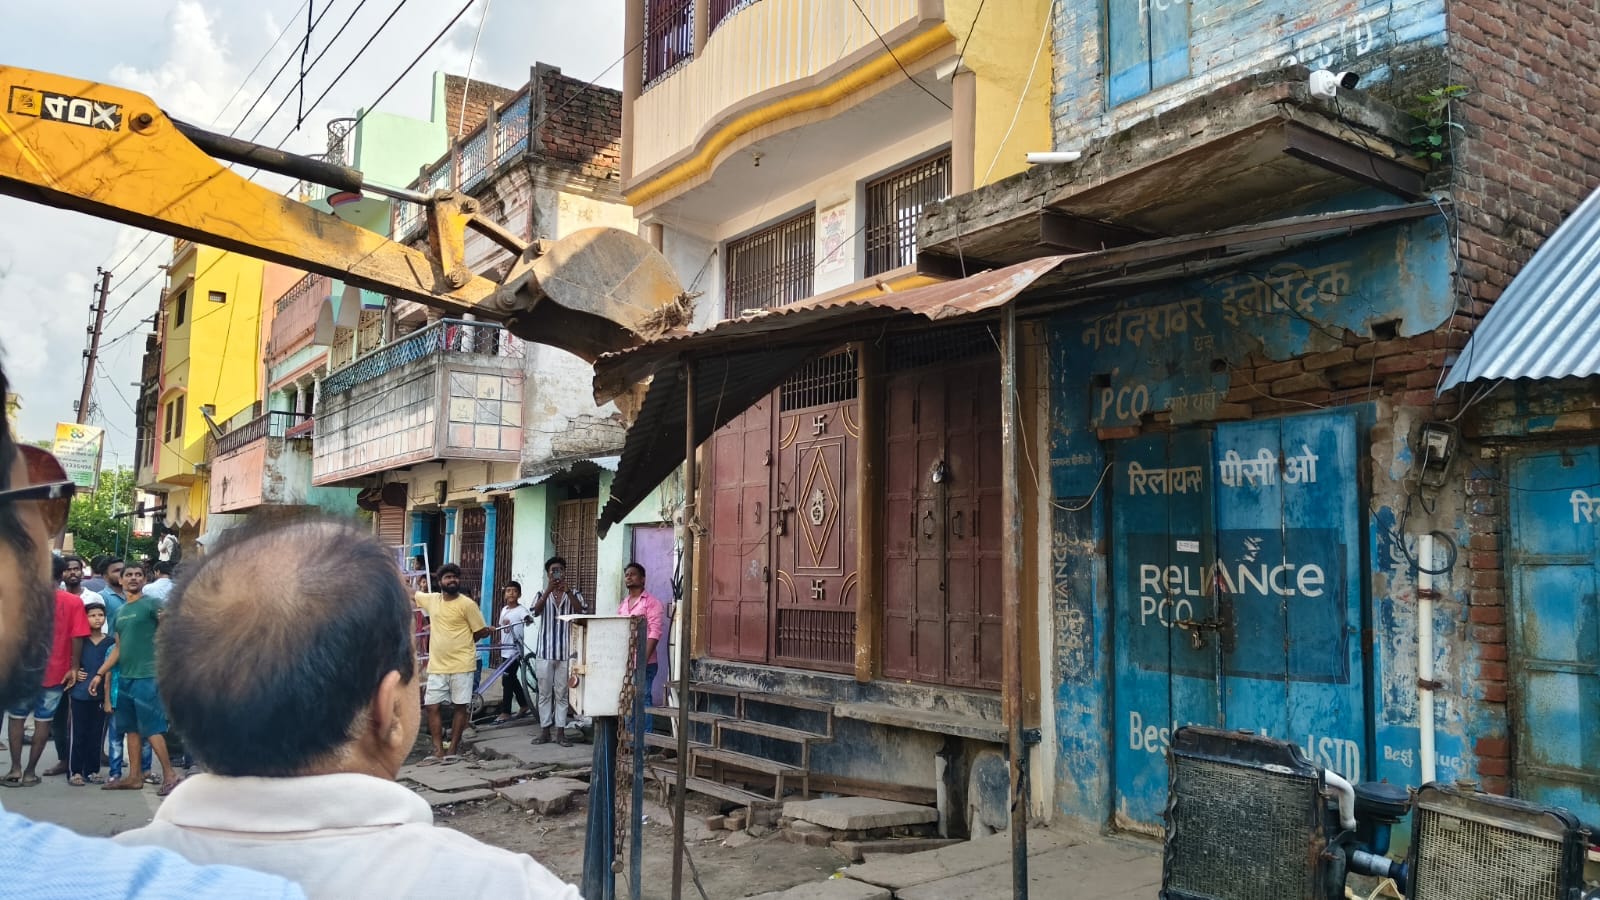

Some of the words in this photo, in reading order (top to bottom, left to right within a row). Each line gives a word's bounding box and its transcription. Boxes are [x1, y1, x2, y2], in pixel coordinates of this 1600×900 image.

[1101, 384, 1149, 420] PCO
[1140, 596, 1193, 630] PCO
[1384, 745, 1413, 768] Best
